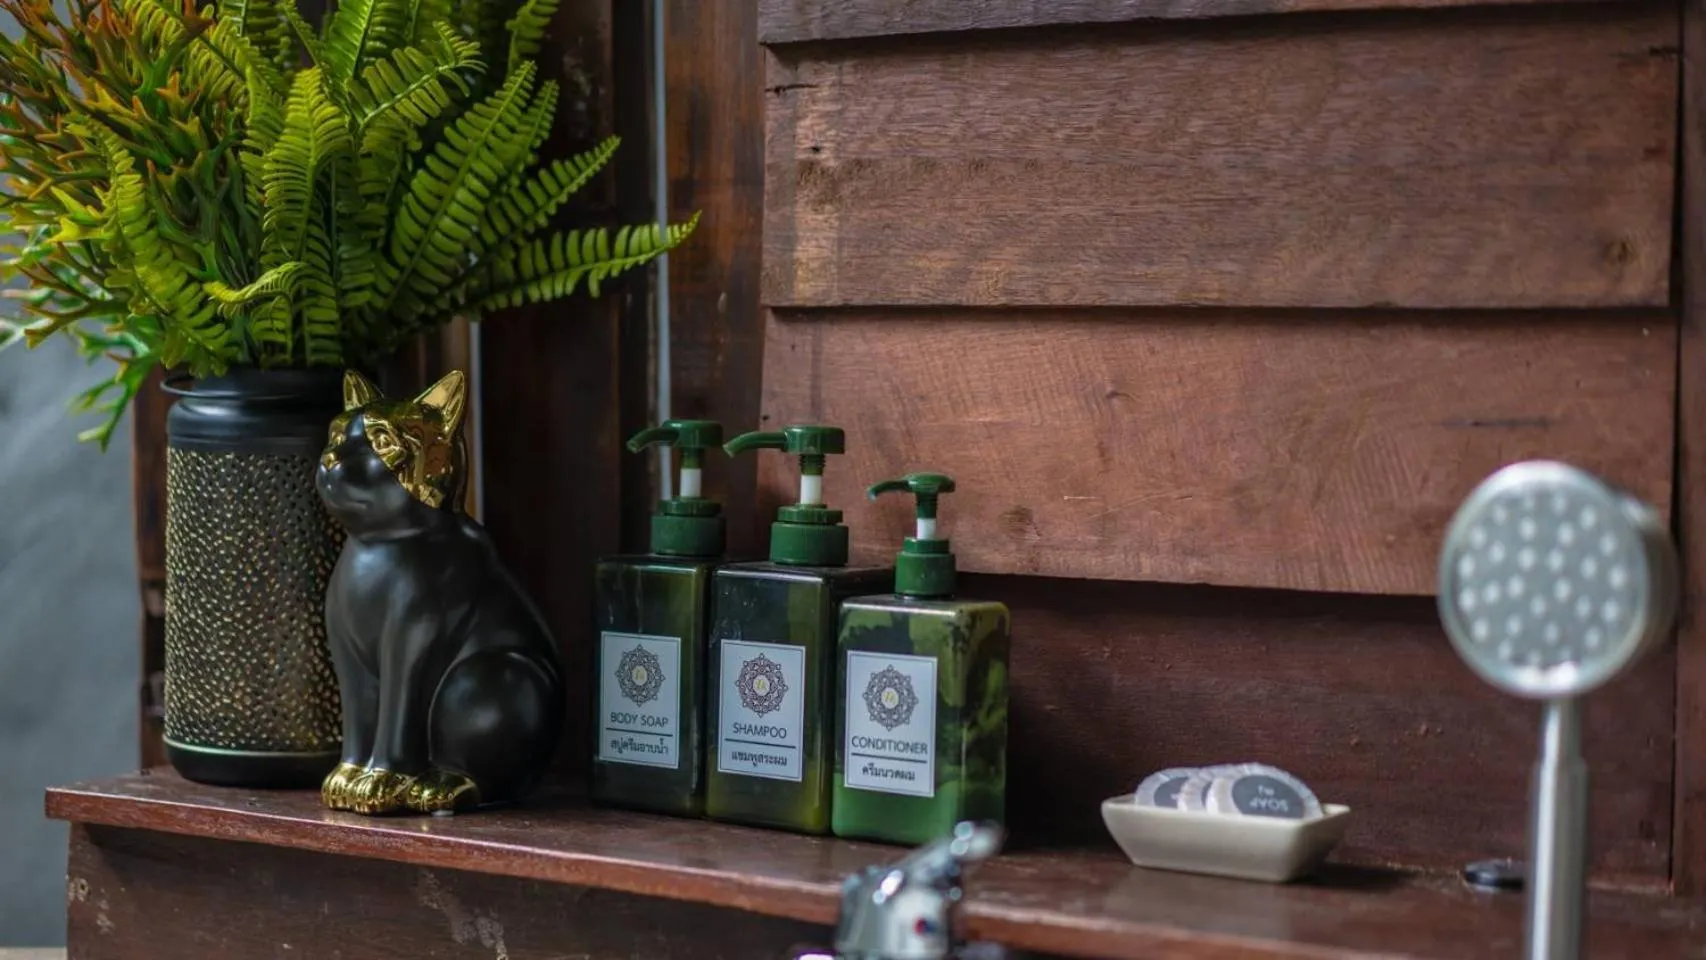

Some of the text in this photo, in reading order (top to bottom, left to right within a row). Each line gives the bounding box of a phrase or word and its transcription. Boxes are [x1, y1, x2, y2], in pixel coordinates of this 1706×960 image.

[610, 711, 669, 728] BODY SOAP
[732, 722, 788, 739] SHAMPOO
[851, 735, 929, 755] CONDITIONER
[862, 762, 916, 781] ครีมนวดผม
[1249, 796, 1289, 813] SOAP
